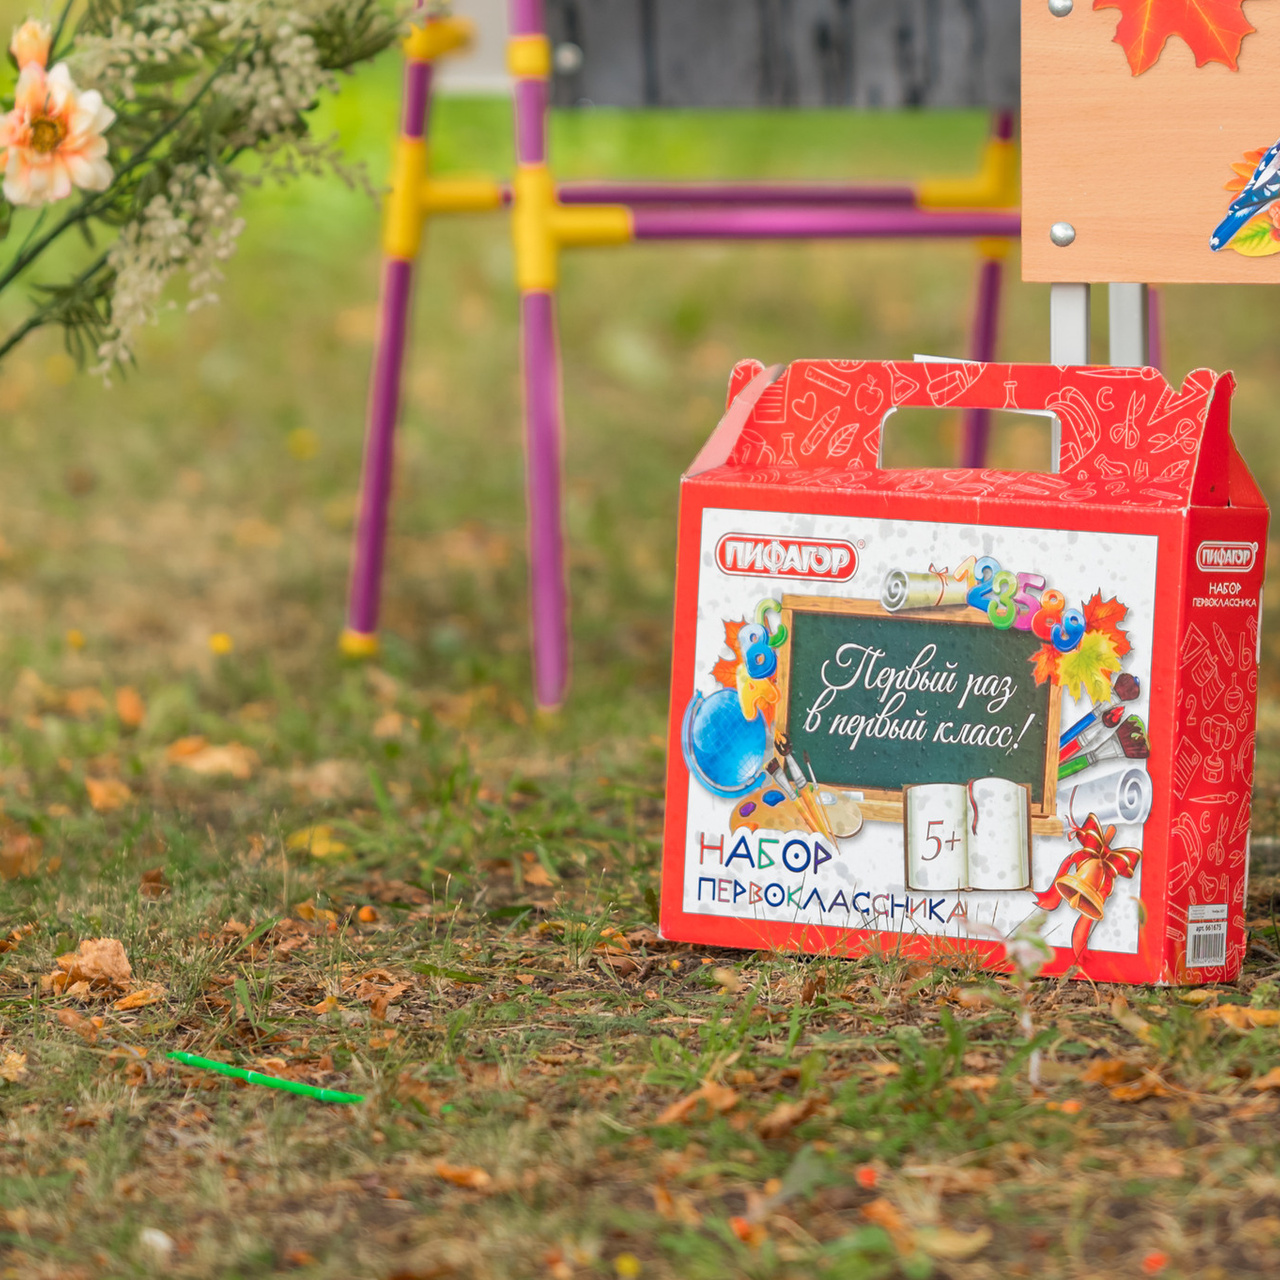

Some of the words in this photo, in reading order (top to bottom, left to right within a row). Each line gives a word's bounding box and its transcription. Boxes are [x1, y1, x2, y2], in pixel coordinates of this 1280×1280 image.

[725, 540, 850, 575] ПИФАГОР
[1202, 548, 1250, 566] ПИФАГОР
[1192, 597, 1257, 608] ПЕРВОКЛАССНИКА
[1208, 582, 1242, 595] НАБОР
[821, 642, 959, 703] Первый
[957, 673, 1018, 714] раз
[802, 687, 837, 733] в
[828, 691, 928, 751] первый
[932, 713, 1036, 751] класс!
[699, 832, 832, 874] НАБОР
[921, 819, 962, 861] 5+
[698, 876, 968, 924] ПЕРВОКЛАССНИКА
